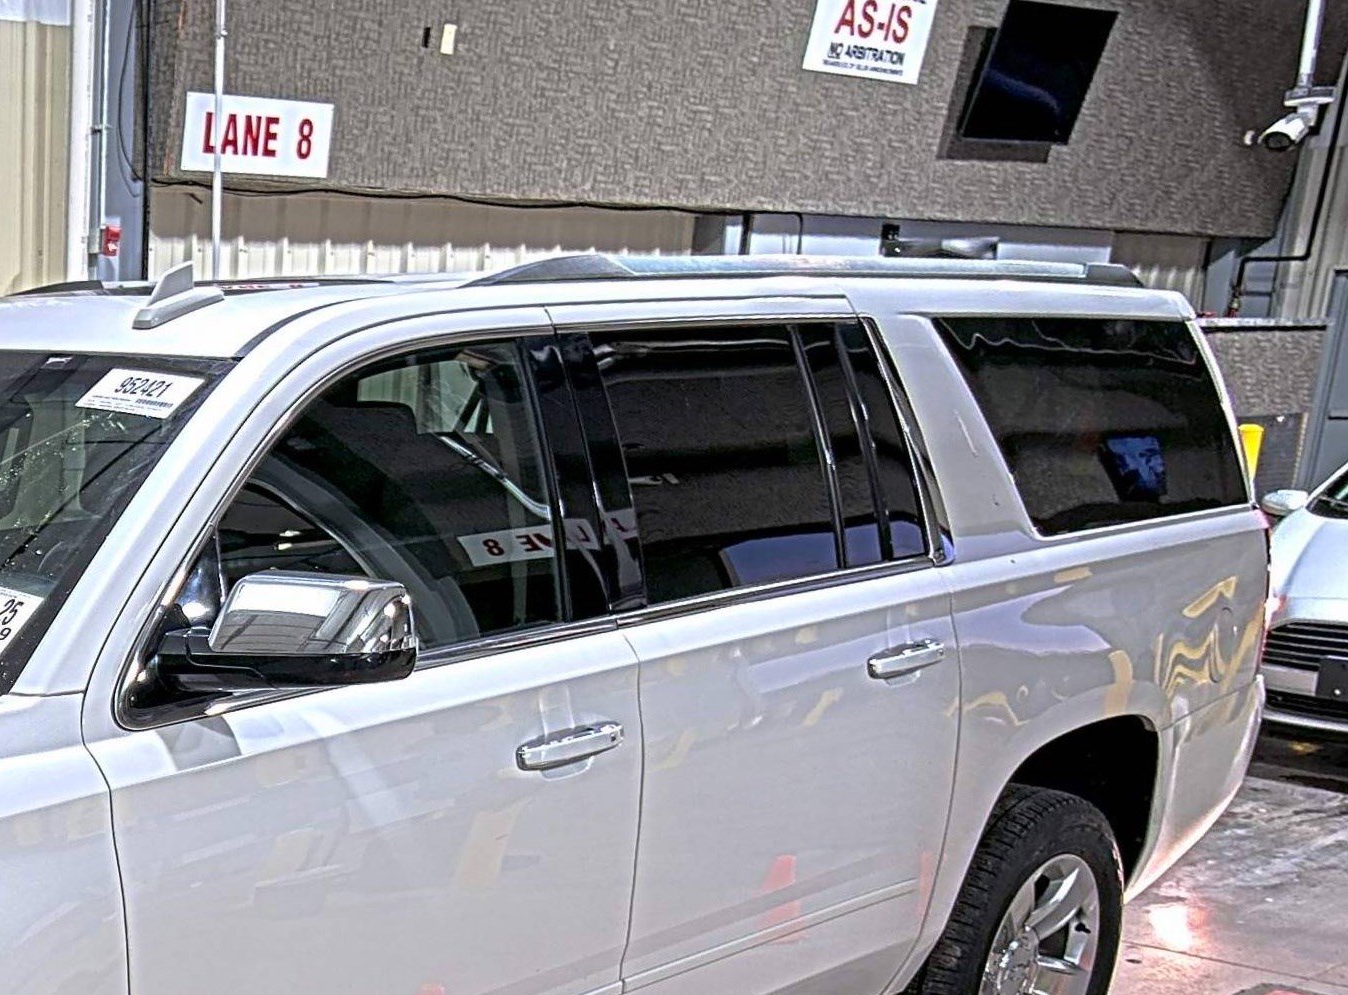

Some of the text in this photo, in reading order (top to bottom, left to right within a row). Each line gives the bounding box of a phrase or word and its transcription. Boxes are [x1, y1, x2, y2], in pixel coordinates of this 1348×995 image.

[834, 0, 912, 44] AS-IS
[202, 111, 314, 160] LANE 8
[114, 376, 173, 398] 952421
